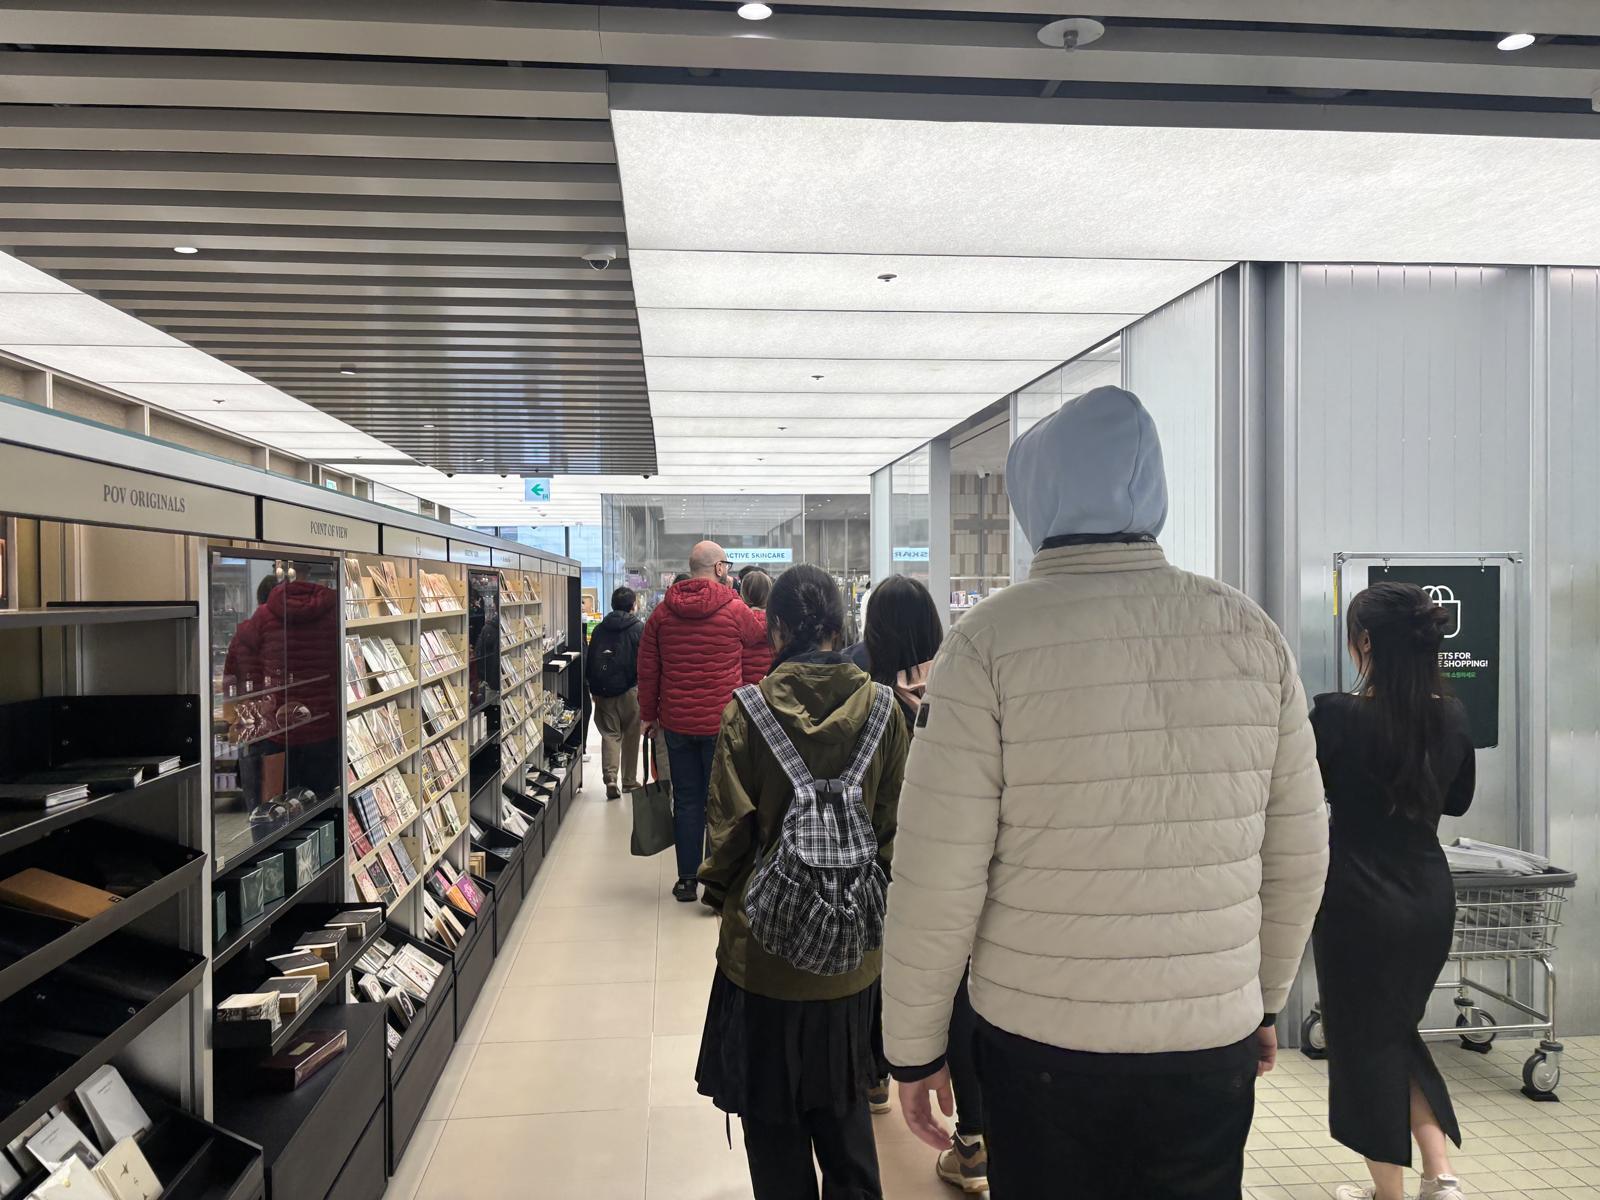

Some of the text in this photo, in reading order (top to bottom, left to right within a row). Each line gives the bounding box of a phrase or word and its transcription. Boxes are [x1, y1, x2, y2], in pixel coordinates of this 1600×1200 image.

[104, 484, 186, 513] POV ORIGINALS
[310, 520, 348, 540] POINT OF VIEW
[1437, 652, 1471, 660] ETS FOR
[1443, 660, 1488, 668] SHOPPING!
